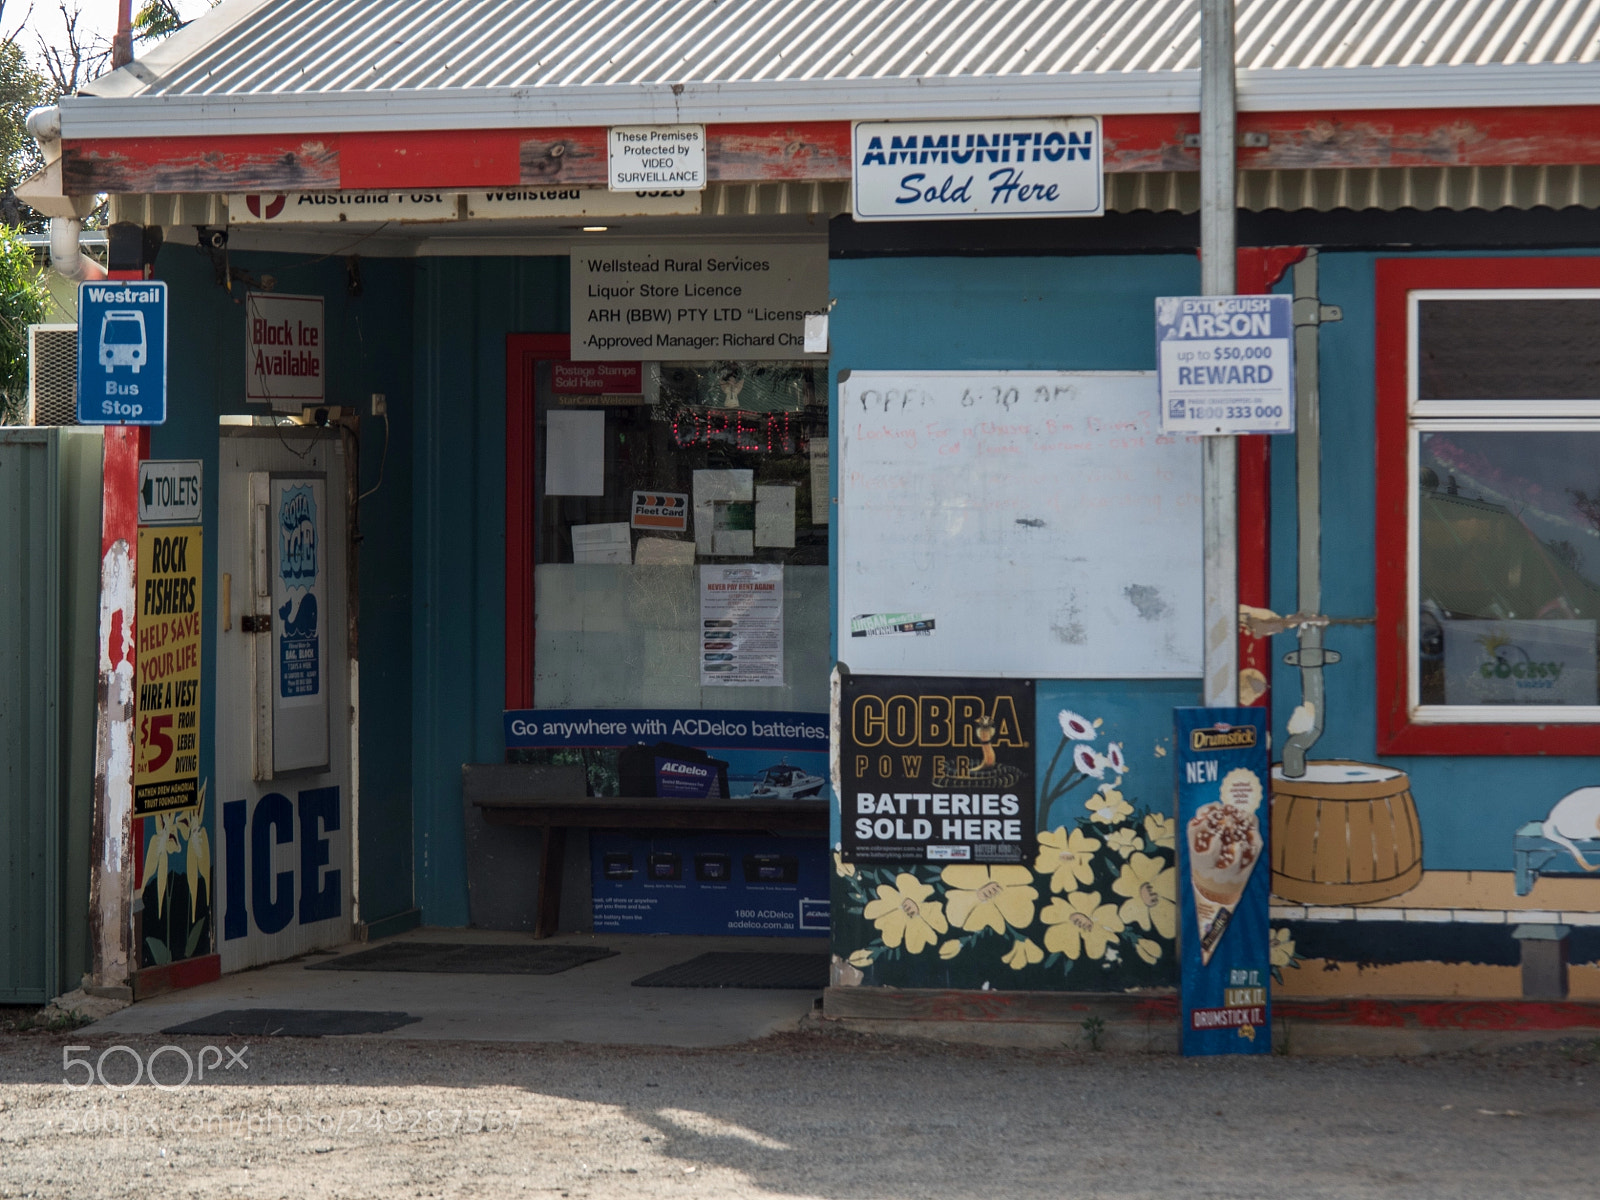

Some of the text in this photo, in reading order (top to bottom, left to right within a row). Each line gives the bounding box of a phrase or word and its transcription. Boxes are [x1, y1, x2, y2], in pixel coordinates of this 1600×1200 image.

[616, 131, 699, 142] These Premises
[624, 144, 690, 157] Protected by
[861, 131, 1093, 166] AMMUNITION
[641, 158, 674, 168] VIDEO
[617, 172, 699, 183] SURVEILLANCE
[894, 168, 1060, 204] Sold Here
[588, 258, 770, 272] Wellstead Rural Services
[88, 287, 160, 304] Westrail
[588, 284, 742, 300] Liquor Store Licence
[588, 309, 621, 322] ARH
[626, 308, 672, 324] (BBW)
[678, 308, 708, 322] PTY
[714, 308, 742, 321] LTD
[252, 318, 319, 347] Block Ice
[1178, 314, 1272, 338] ARSON
[588, 334, 652, 350] Approved
[656, 334, 720, 350] Manager:
[723, 333, 775, 346] Richard
[254, 349, 320, 378] Available
[1177, 346, 1272, 363] up to $50,000
[555, 365, 636, 378] Postage Stamps
[1178, 364, 1273, 386] REWARD
[105, 381, 140, 396] Bus
[555, 378, 604, 388] Sold Here
[101, 400, 143, 417] Stop
[1188, 406, 1223, 420] 1800
[1226, 406, 1252, 419] 333
[1254, 406, 1283, 418] 000
[673, 410, 789, 450] OPEN
[155, 476, 198, 508] TOILETS
[636, 506, 684, 518] Fleet Card
[152, 536, 188, 574] ROCK
[282, 520, 316, 578] ICE
[144, 576, 196, 616] FISHERS
[140, 611, 200, 653] HELP SAVE
[140, 643, 198, 684] YOUR LIFE
[139, 680, 198, 712] HIRE A VEST
[178, 711, 196, 729] FROM
[852, 694, 1024, 748] COBRA
[511, 719, 830, 740] Go anywhere with ACDelco batteries.
[176, 732, 196, 752] LEBEN
[1194, 730, 1254, 749] Drumstick
[138, 763, 148, 773] DAY
[174, 755, 197, 774] DIVING
[661, 762, 708, 776] ACDelco
[856, 755, 971, 779] POWER
[1186, 760, 1218, 784] NEW
[170, 782, 195, 794] MEMORIAL
[144, 794, 188, 809] TRUST FOUNDATION
[857, 792, 1020, 815] BATTERIES
[855, 818, 1022, 841] SOLD HERE
[223, 785, 341, 941] ICE
[735, 910, 794, 919] 1800 ACDelco
[728, 920, 794, 930] acdelco.com.au
[1230, 969, 1262, 986] RIP IT.
[1228, 989, 1266, 1006] LICK IT.
[1194, 1008, 1264, 1028] DRUMSTICK IT.
